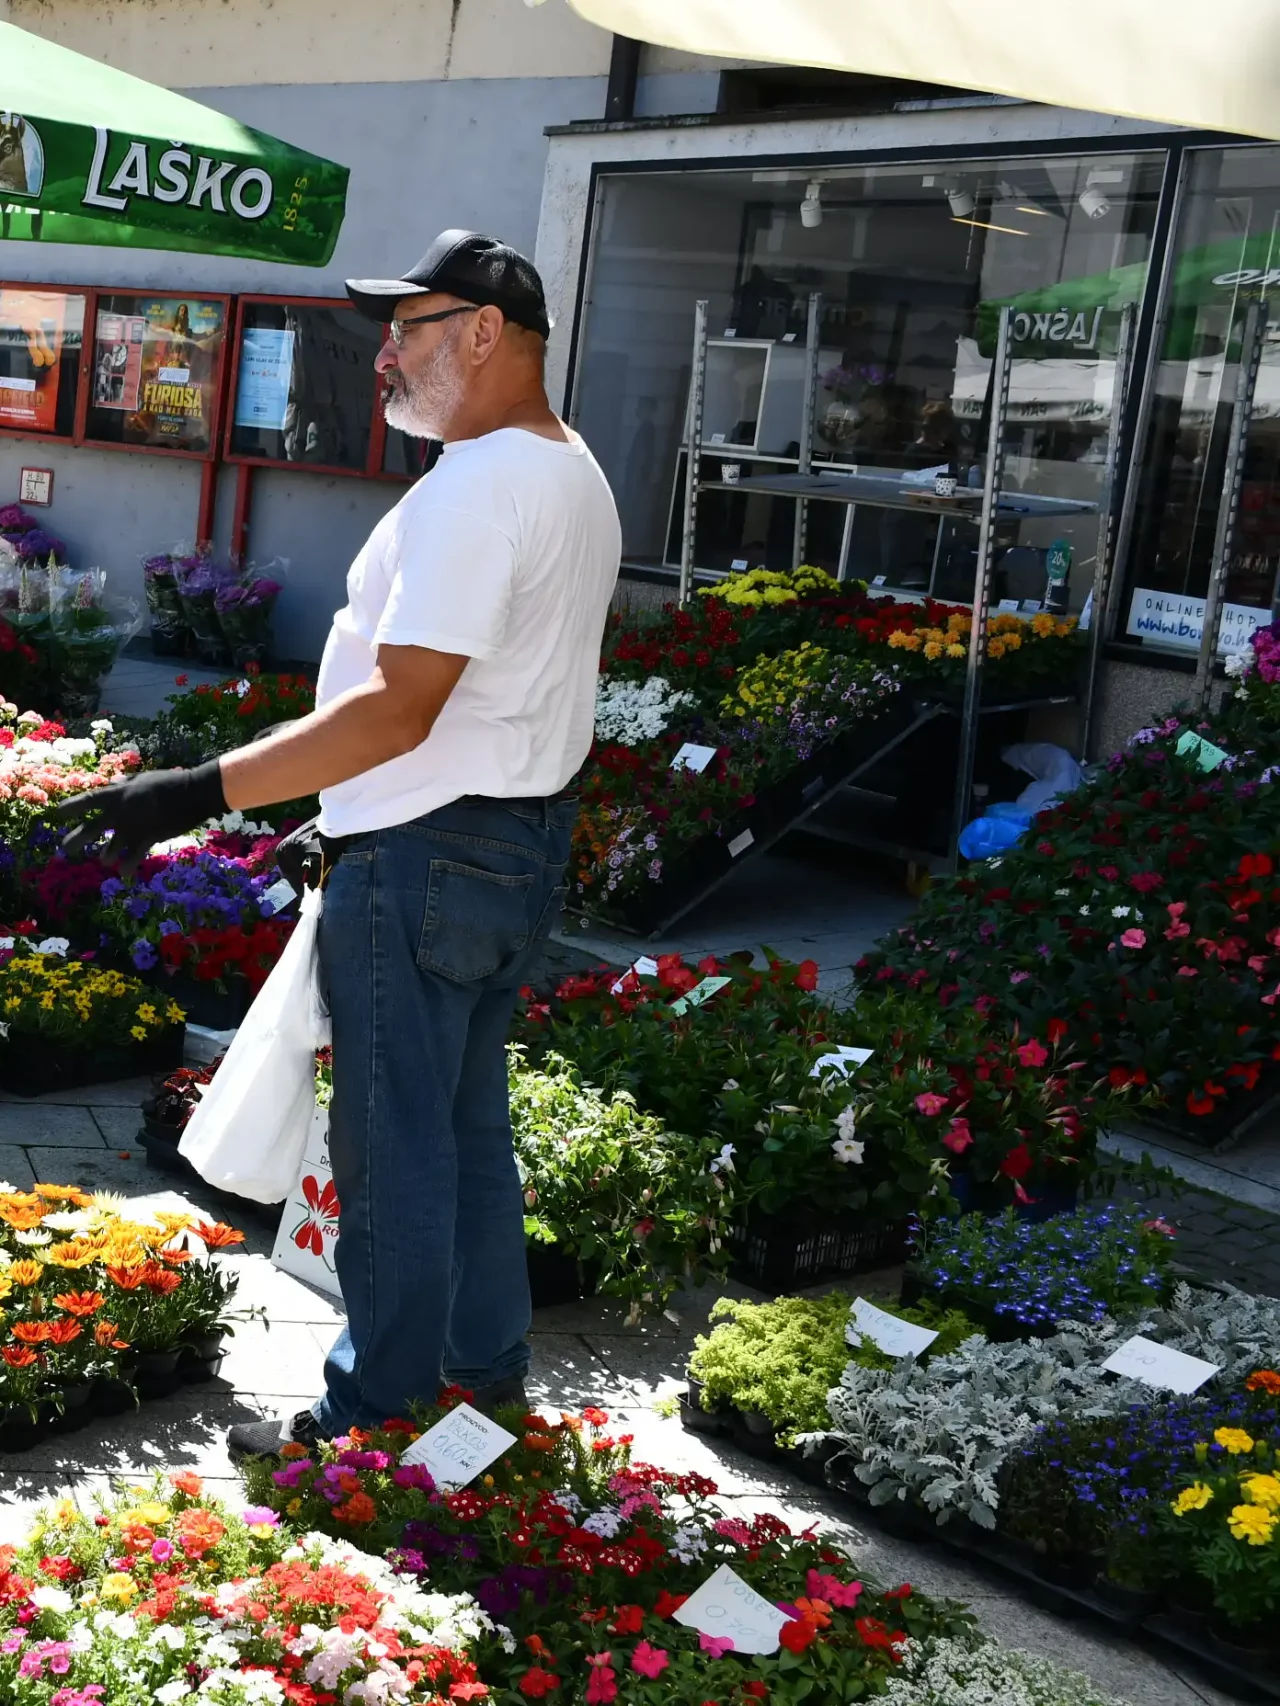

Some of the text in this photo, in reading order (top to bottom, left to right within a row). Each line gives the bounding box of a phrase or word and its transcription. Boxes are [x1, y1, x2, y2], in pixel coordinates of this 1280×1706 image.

[82, 127, 275, 220] LAŠKO
[144, 383, 203, 408] FURIOSA
[1146, 598, 1257, 627] ONLINE HOP
